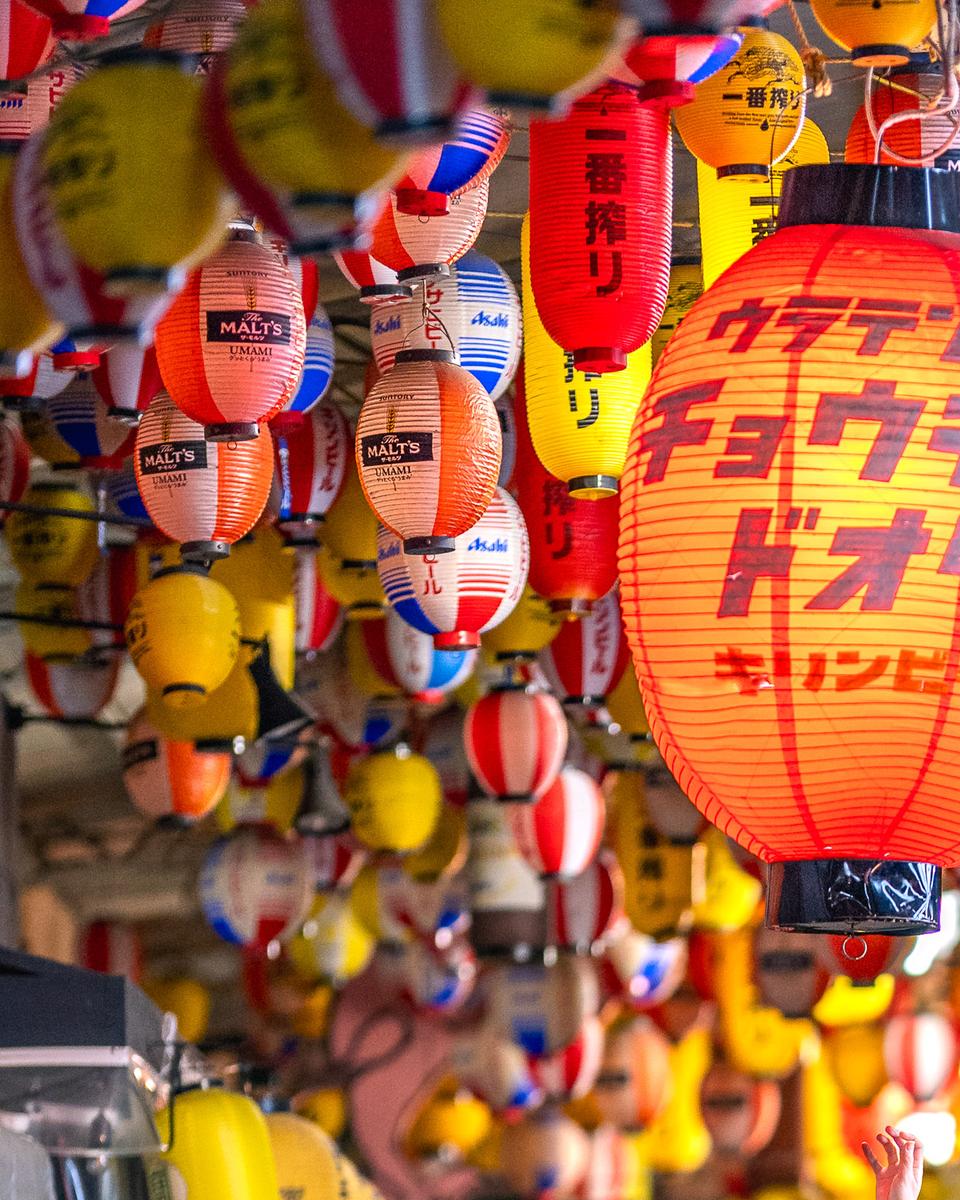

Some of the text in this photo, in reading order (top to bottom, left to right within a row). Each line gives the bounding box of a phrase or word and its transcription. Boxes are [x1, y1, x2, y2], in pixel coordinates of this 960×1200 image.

[722, 87, 800, 110] 一番搾り
[585, 129, 627, 300] 一番搾り
[242, 312, 263, 321] The
[471, 309, 509, 328] Asahi
[220, 320, 283, 336] MALT'S
[229, 346, 272, 355] UMAMI
[381, 435, 399, 445] The
[157, 445, 175, 454] The
[367, 440, 420, 458] MALT'S
[145, 449, 195, 468] MALT'S
[152, 474, 187, 485] UMAMI
[375, 466, 412, 478] UMAMI
[468, 536, 508, 553] Asahi
